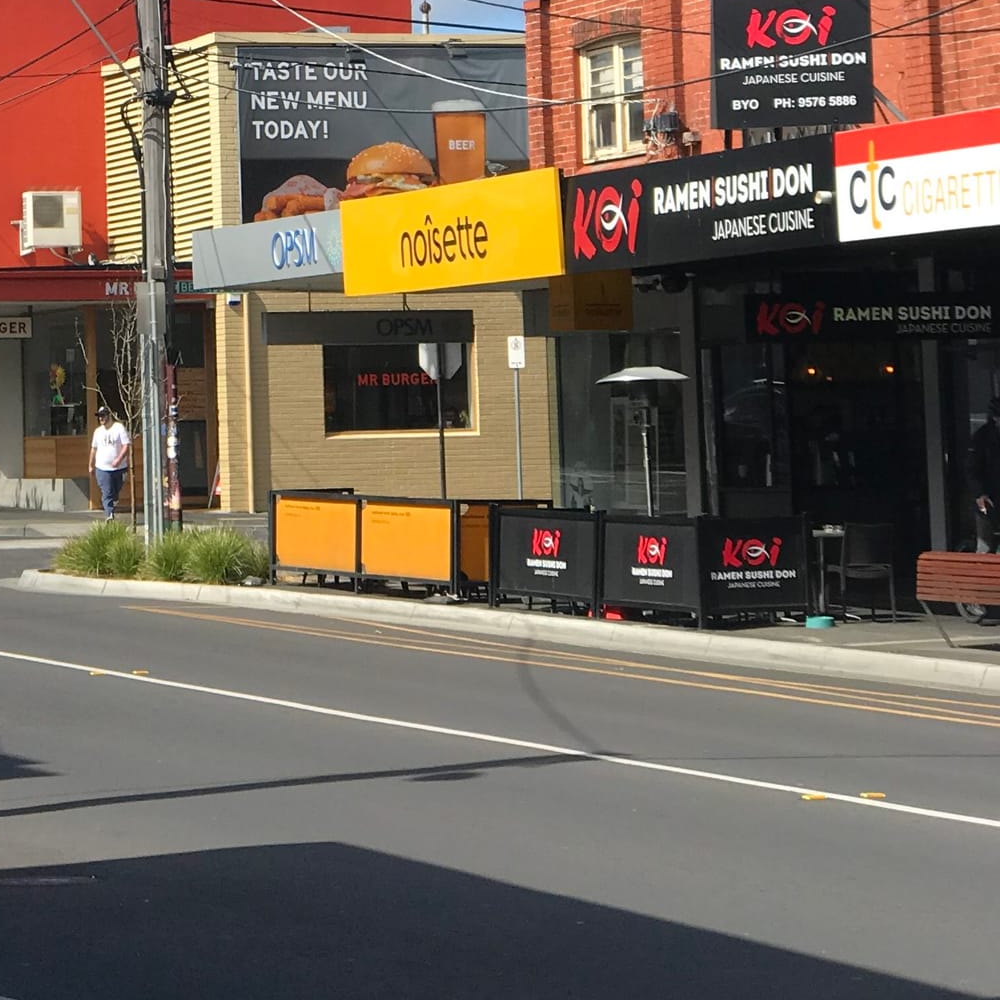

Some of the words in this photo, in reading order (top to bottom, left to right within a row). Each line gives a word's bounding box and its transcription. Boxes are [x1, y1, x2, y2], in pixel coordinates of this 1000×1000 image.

[720, 55, 775, 70] RAMEN
[778, 53, 828, 67] SUSHI
[831, 52, 867, 65] DON
[252, 62, 317, 81] TASTE
[323, 62, 368, 81] OUR
[742, 73, 798, 86] JAPANESE
[800, 71, 845, 83] CUISINE
[251, 91, 300, 110] NEW
[307, 91, 368, 110] MENU
[732, 99, 759, 111] BYO
[773, 98, 795, 109] PH:
[798, 96, 826, 108] 9576
[828, 95, 857, 107] 5886
[252, 120, 329, 139] TODAY!
[448, 139, 475, 151] BEER
[653, 179, 711, 215] RAMEN
[714, 170, 769, 206] SUSHI
[772, 163, 813, 198] DON
[712, 215, 767, 241] JAPANESE
[768, 208, 815, 233] CUISINE
[271, 227, 318, 270] OPSM
[400, 214, 488, 268] noîsette
[105, 282, 129, 297] MR
[833, 306, 893, 322] RAMEN
[898, 305, 951, 321] SUSHI
[955, 304, 992, 320] DON
[376, 318, 433, 337] OPSM
[896, 322, 949, 334] JAPANESE
[951, 322, 992, 334] CUISINE
[357, 373, 379, 387] MR
[710, 571, 743, 580] RAMEN
[745, 570, 774, 580] SUSHI
[776, 569, 797, 578] DON
